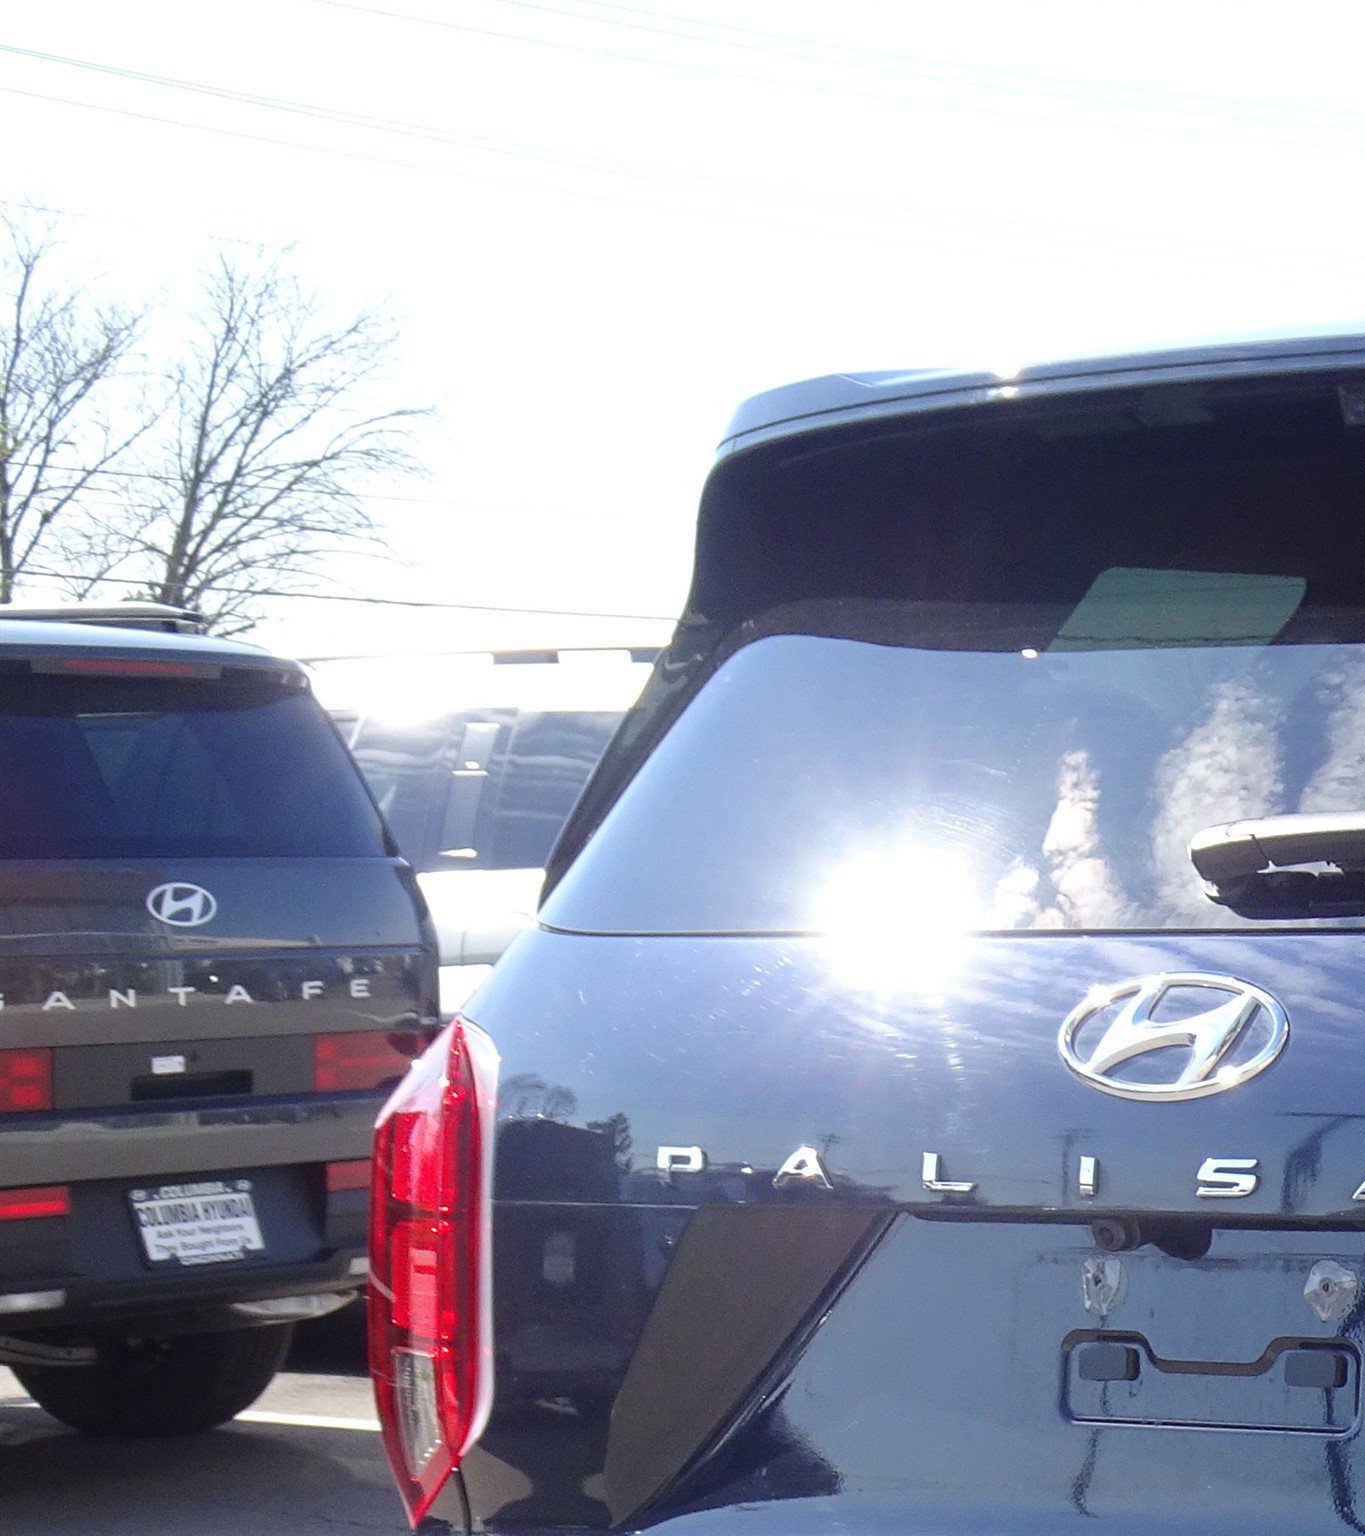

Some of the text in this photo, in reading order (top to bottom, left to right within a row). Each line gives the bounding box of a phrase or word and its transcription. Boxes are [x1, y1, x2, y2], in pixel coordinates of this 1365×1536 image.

[0, 979, 371, 1012] ANTA FE
[139, 1198, 254, 1227] COLUMBIA HYUNDAI
